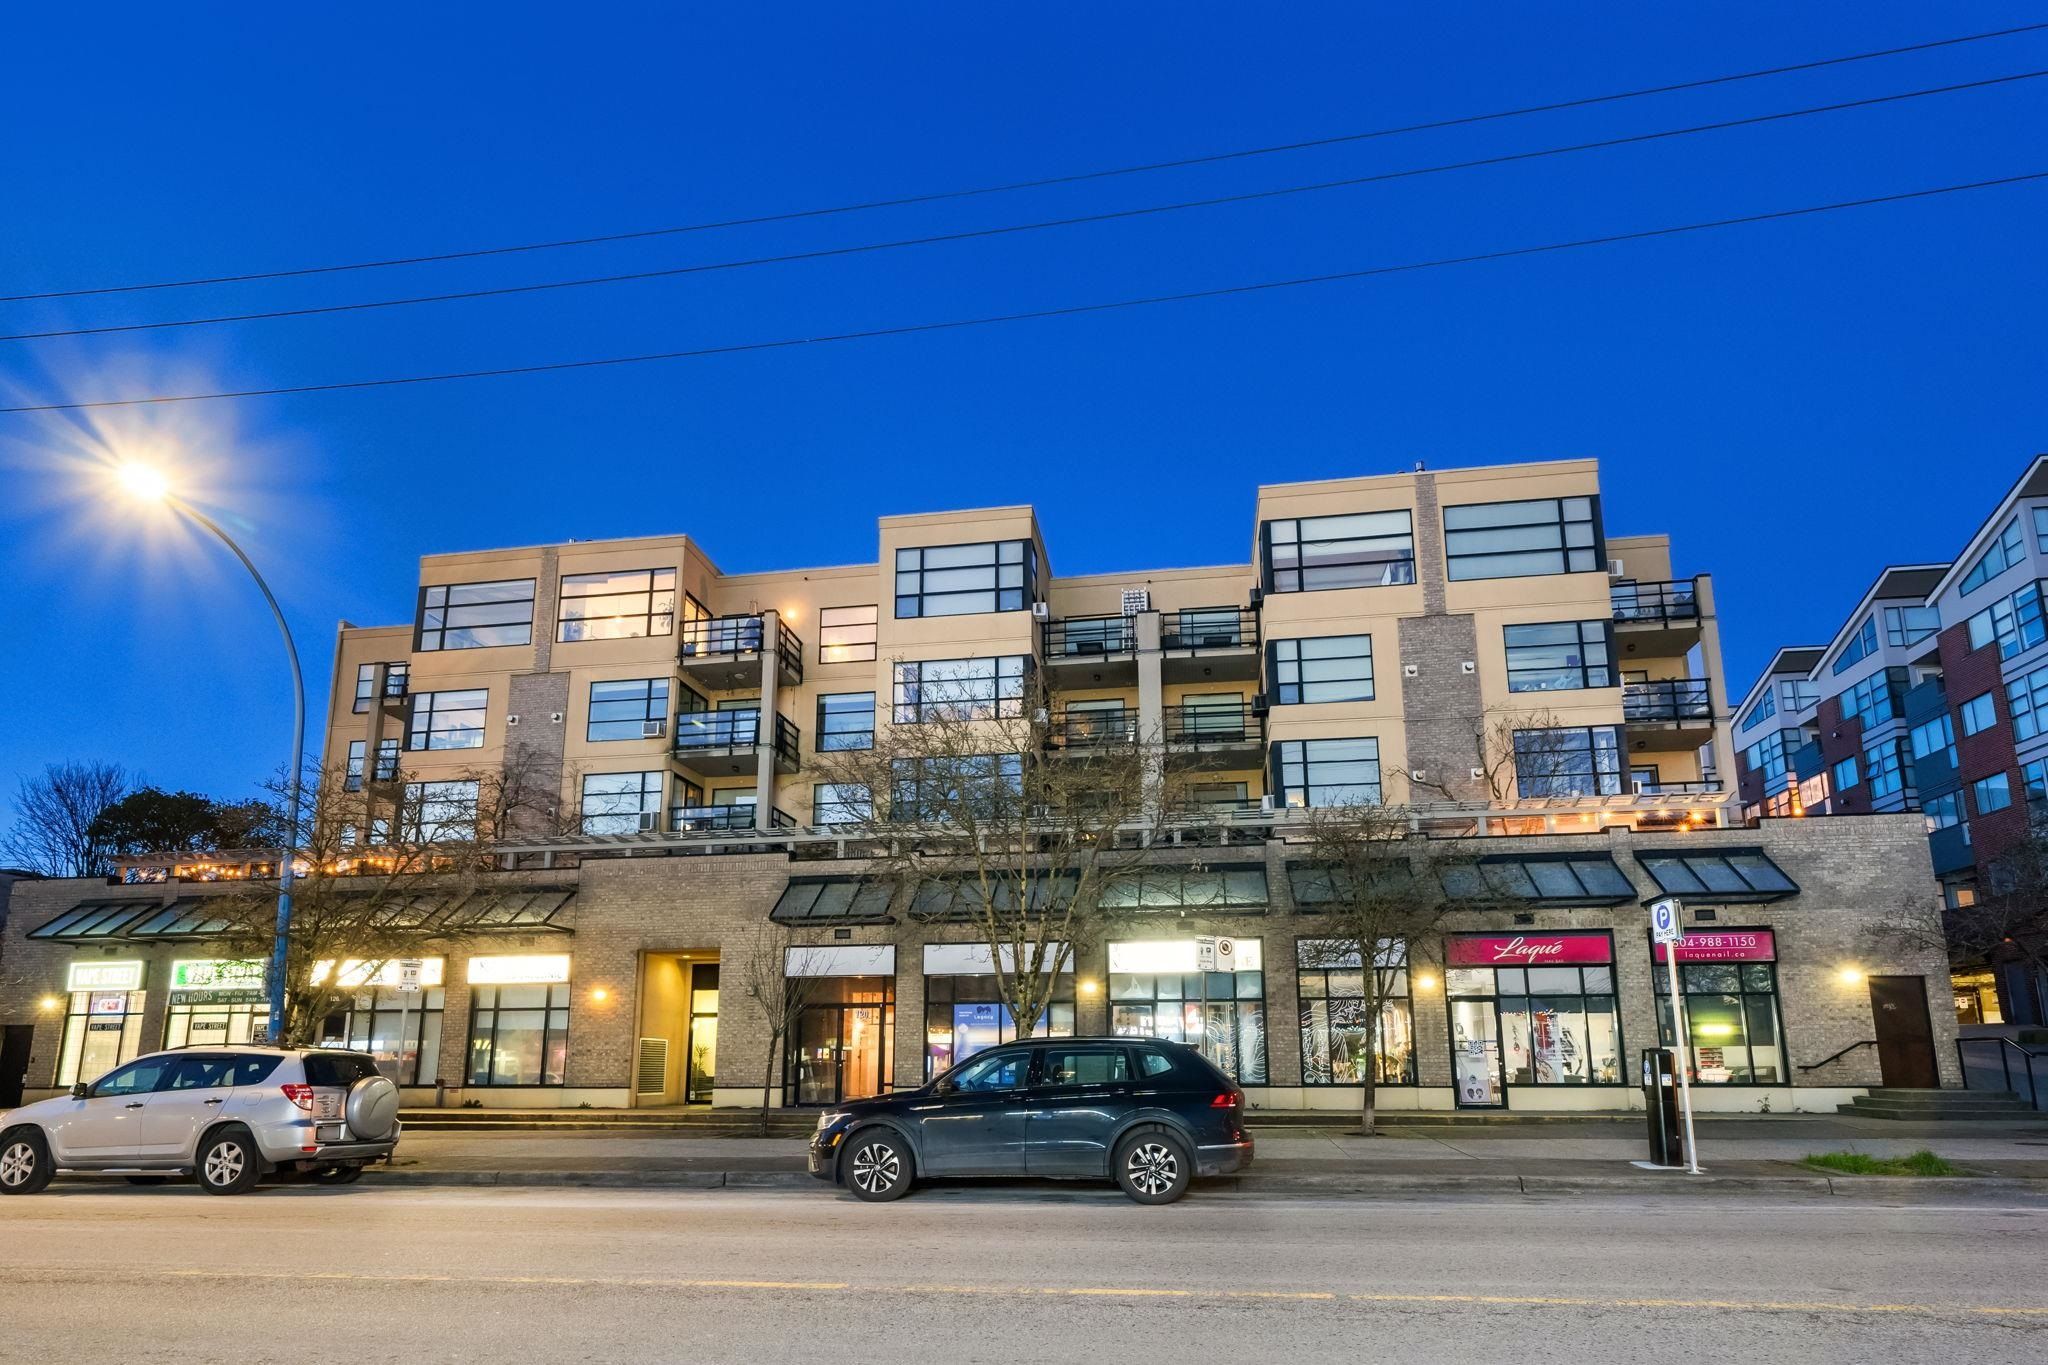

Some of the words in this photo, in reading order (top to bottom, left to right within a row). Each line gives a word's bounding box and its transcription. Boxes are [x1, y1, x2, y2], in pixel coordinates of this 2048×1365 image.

[1664, 928, 1674, 936] HERE
[1493, 937, 1563, 963] Laqué
[1685, 951, 1745, 959] laquenail.ca
[172, 993, 186, 1004] NEW
[188, 991, 213, 1003] HOURS
[208, 1022, 226, 1030] STREET
